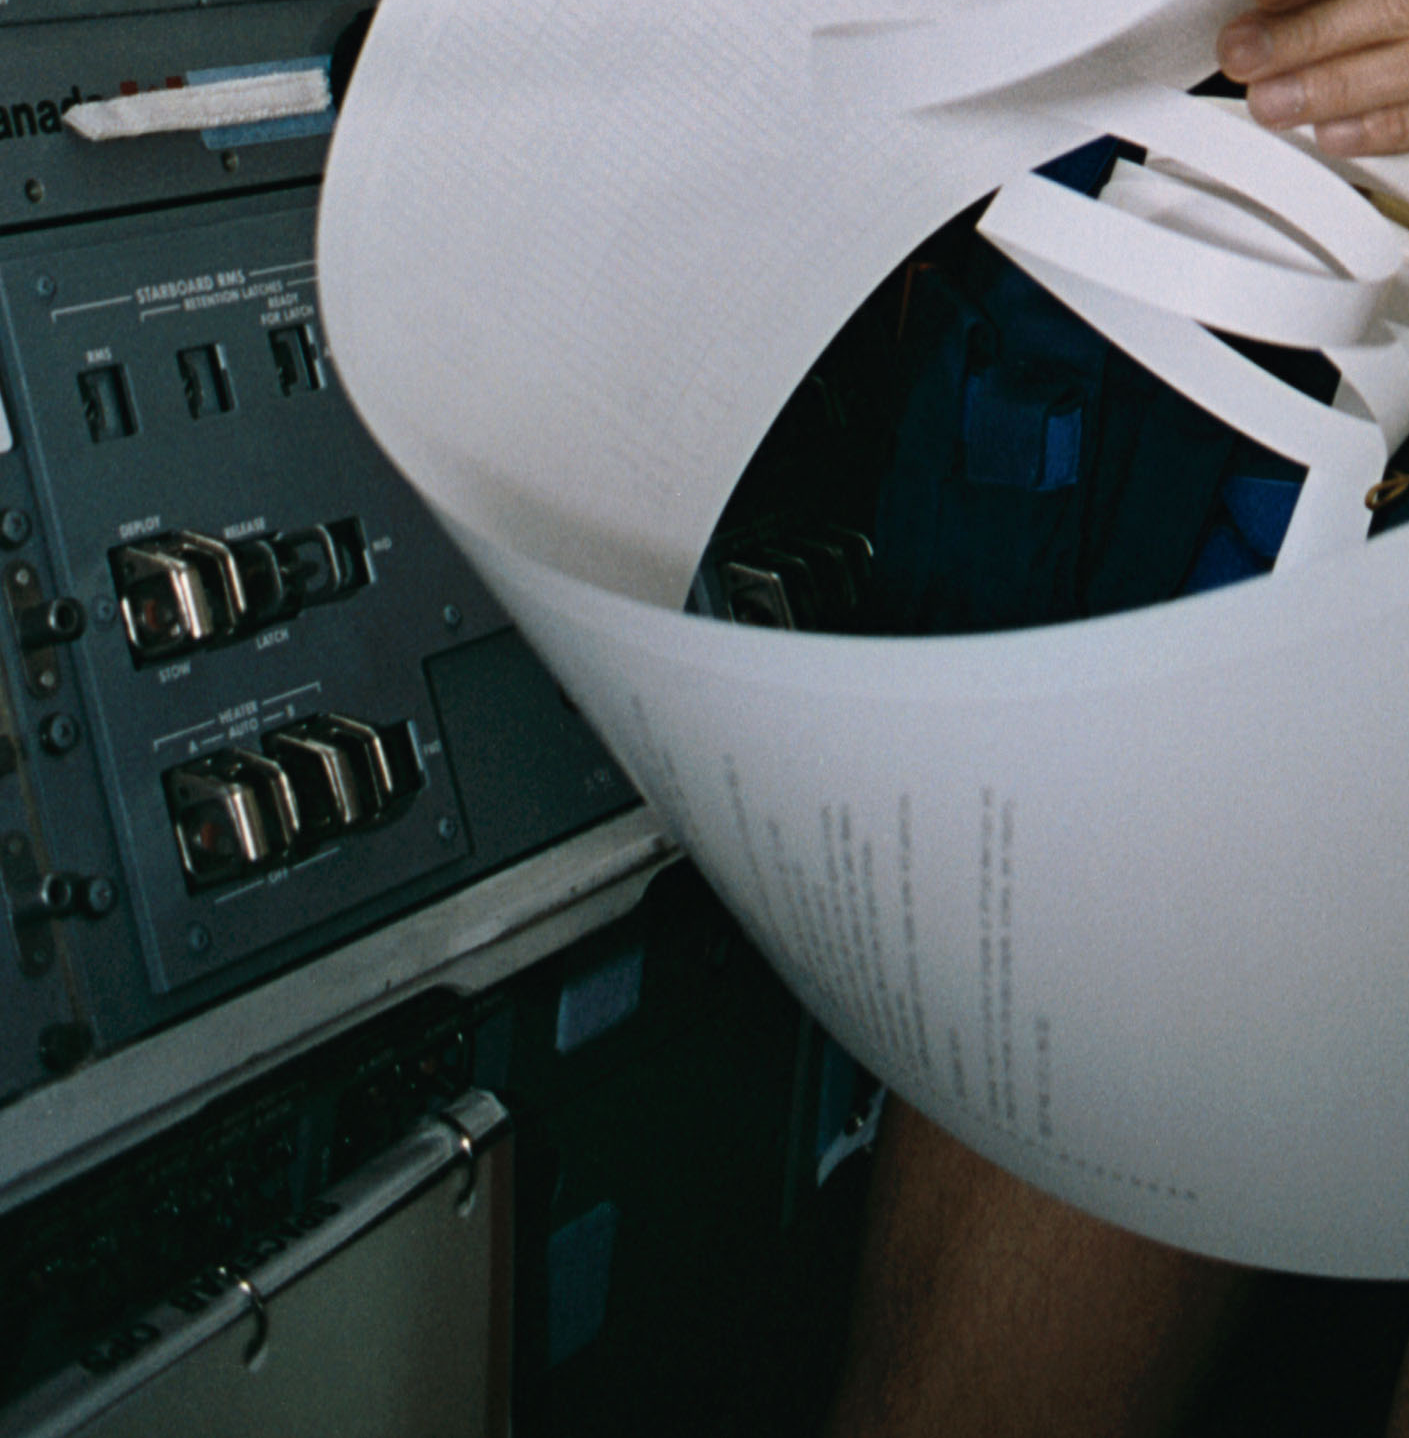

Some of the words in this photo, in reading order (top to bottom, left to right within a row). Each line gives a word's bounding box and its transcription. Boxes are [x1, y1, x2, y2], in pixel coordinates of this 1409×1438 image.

[136, 275, 214, 305] STARBOARD
[217, 269, 246, 289] RMS
[182, 288, 239, 312] RETENTION
[241, 280, 283, 300] LATCHES
[268, 292, 299, 309] READY
[260, 312, 282, 326] FOR
[284, 305, 314, 322] LATCH
[86, 347, 112, 365] RMS
[118, 516, 161, 539] DEPLOY
[223, 516, 267, 540] RELEASE
[256, 628, 289, 650] LATCH
[158, 661, 191, 683] STOW
[218, 700, 258, 724] HEATER
[228, 720, 259, 740] AUTO
